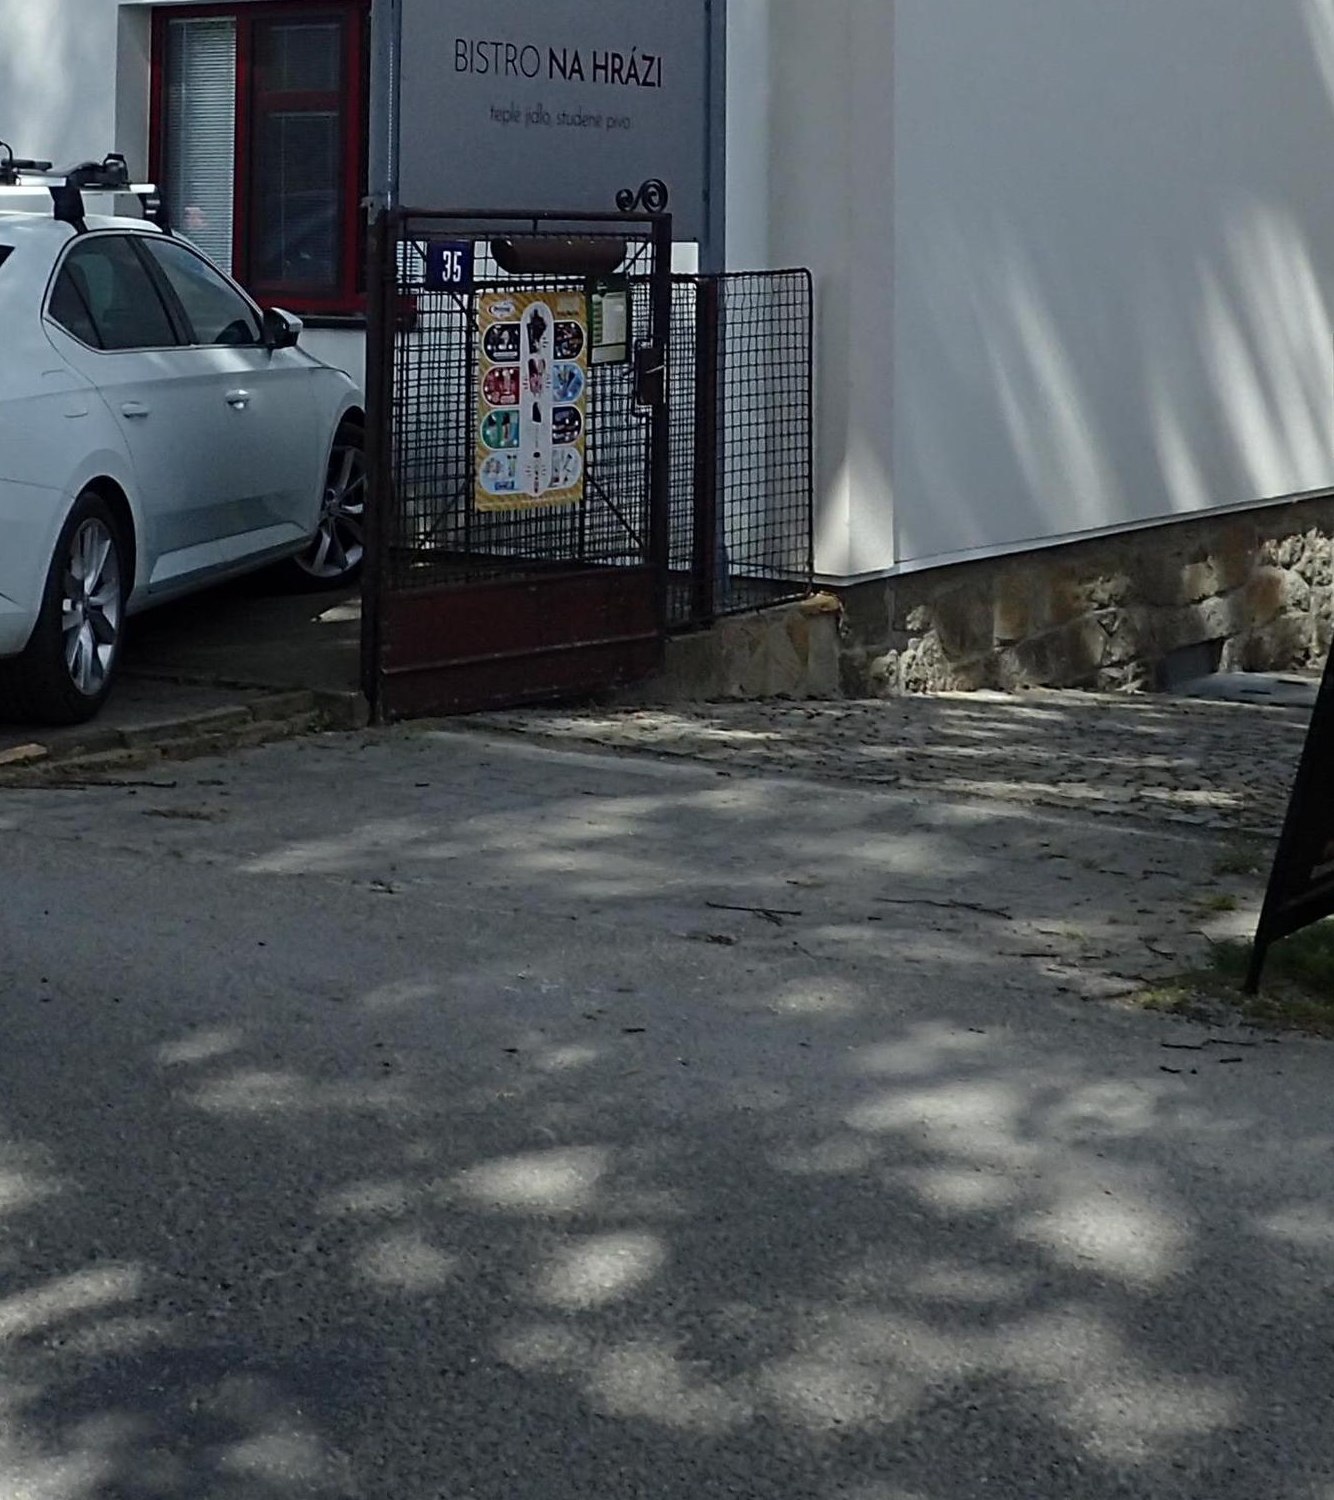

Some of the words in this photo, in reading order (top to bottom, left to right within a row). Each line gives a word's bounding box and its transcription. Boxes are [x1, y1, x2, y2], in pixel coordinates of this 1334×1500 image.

[455, 38, 540, 78] BISTRO
[549, 47, 585, 82] NA
[593, 46, 662, 87] HRÁZI
[442, 250, 462, 283] 35
